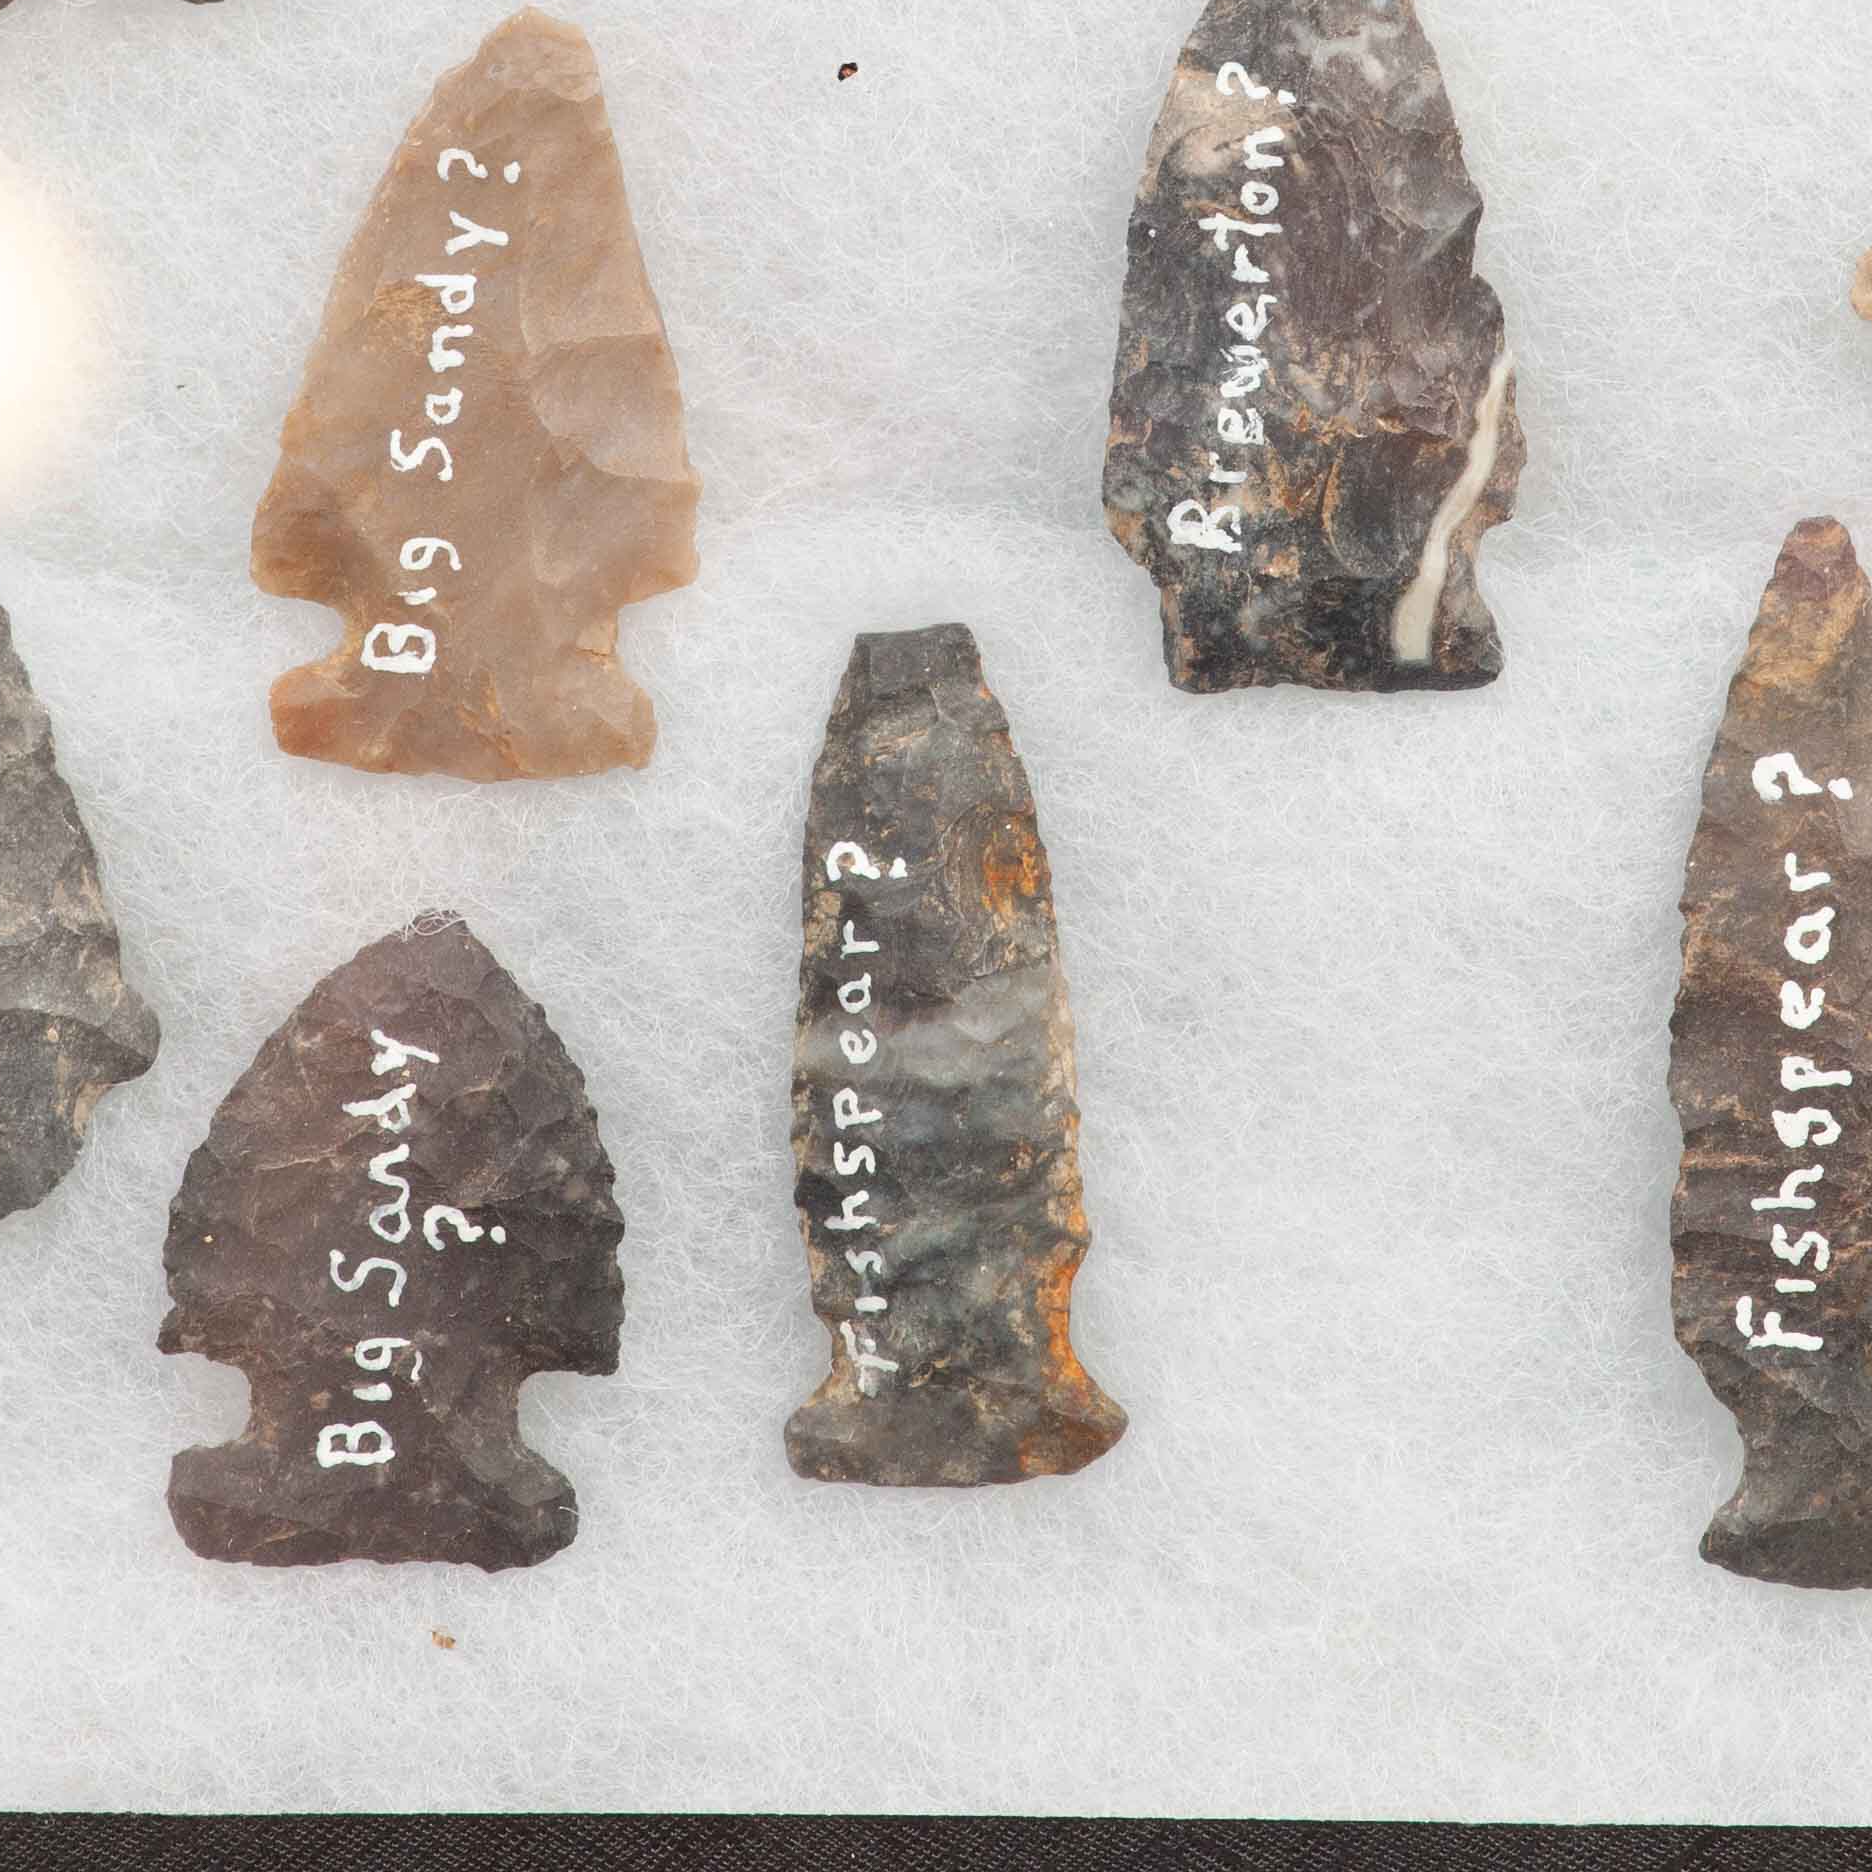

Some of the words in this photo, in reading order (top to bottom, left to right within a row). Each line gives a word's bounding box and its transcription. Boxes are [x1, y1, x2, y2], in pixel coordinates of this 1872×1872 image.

[358, 535, 464, 676] Big
[327, 1027, 443, 1309] Sandy
[421, 1202, 508, 1253] ?
[314, 1335, 425, 1470] Big
